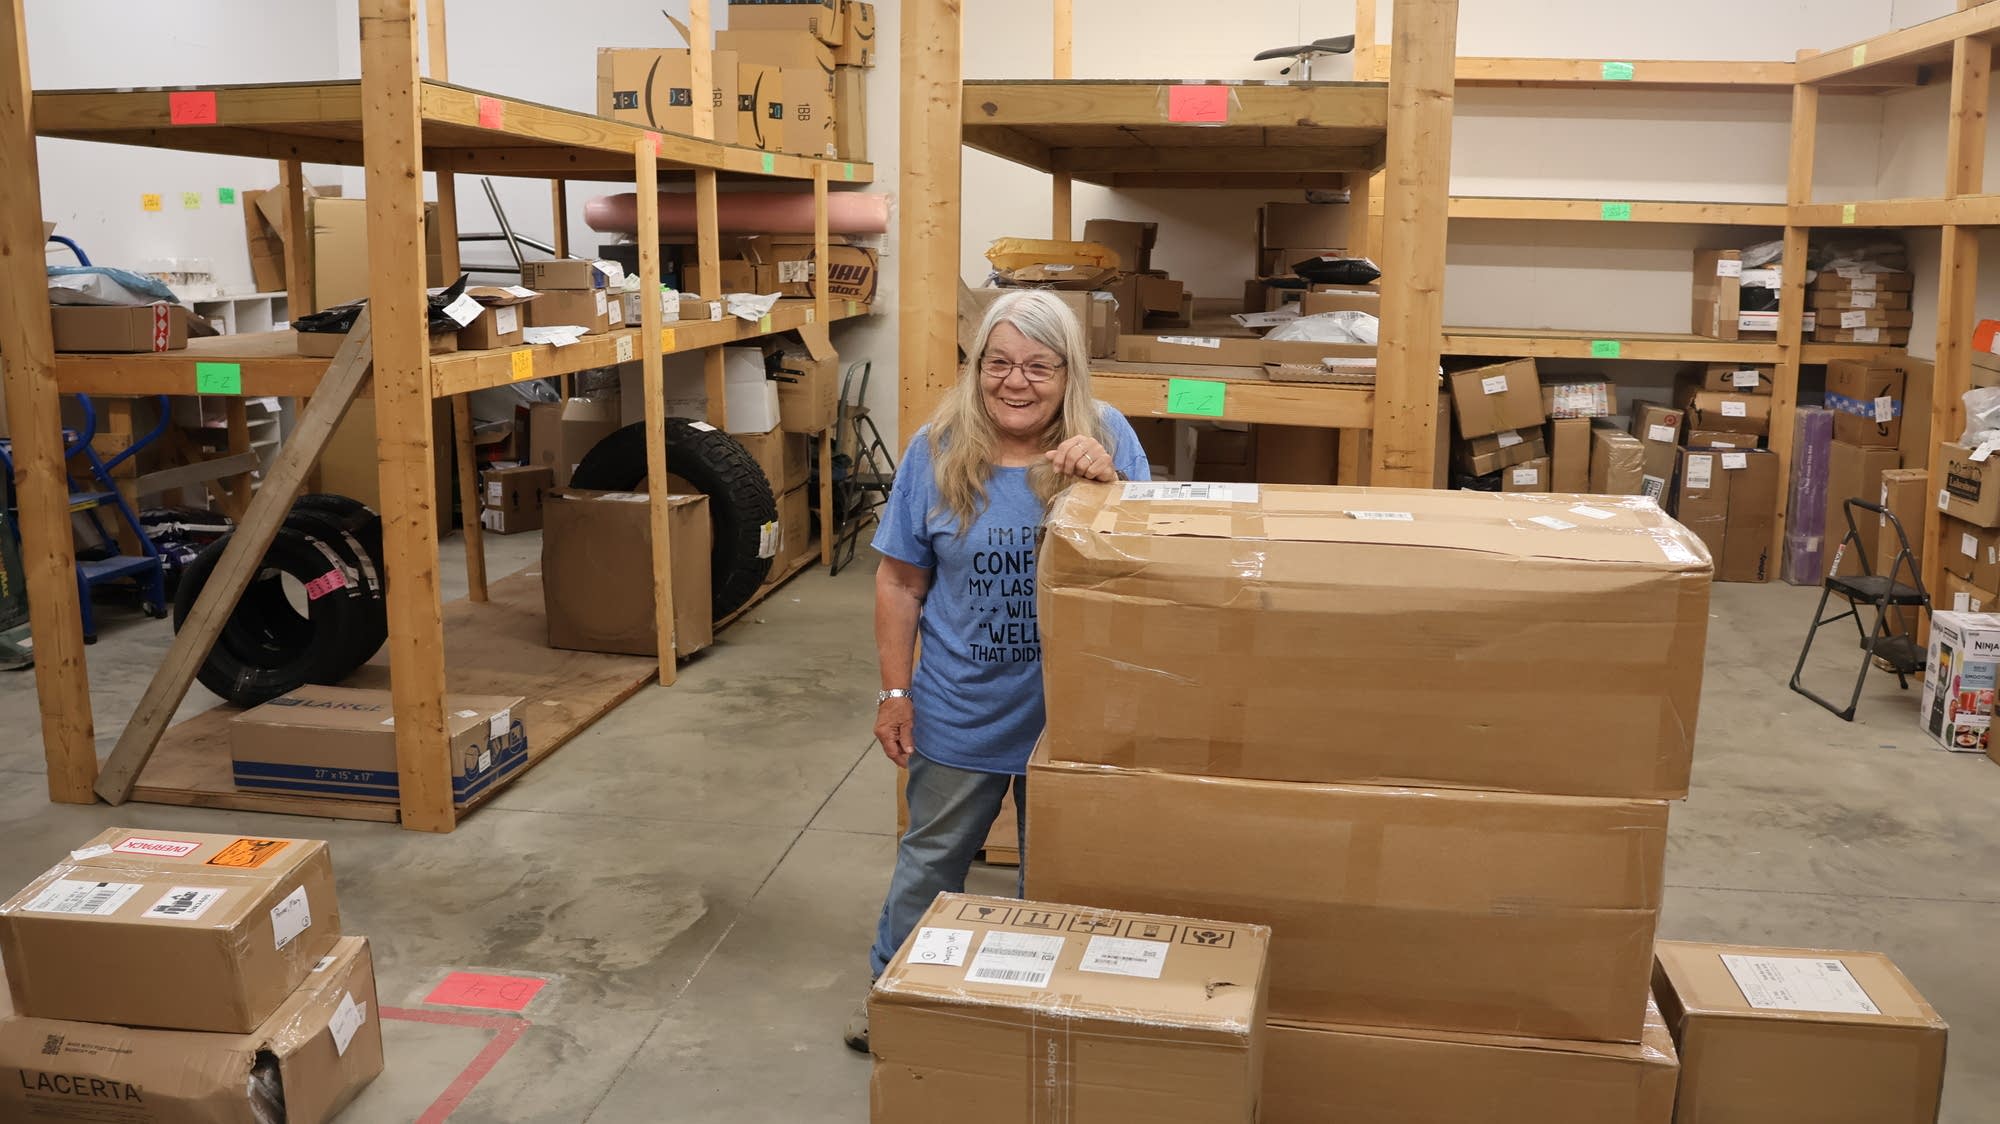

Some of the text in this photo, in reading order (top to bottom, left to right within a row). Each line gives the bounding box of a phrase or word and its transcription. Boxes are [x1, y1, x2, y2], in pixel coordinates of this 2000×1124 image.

[988, 527, 1014, 546] I'M
[973, 551, 1034, 575] CONF
[969, 578, 1036, 597] MY LAS
[970, 644, 1008, 662] THAT
[1974, 641, 2000, 652] NINJA
[302, 700, 383, 712] LARGE
[124, 841, 189, 853] OVERPACK
[19, 1069, 142, 1103] LACERTA
